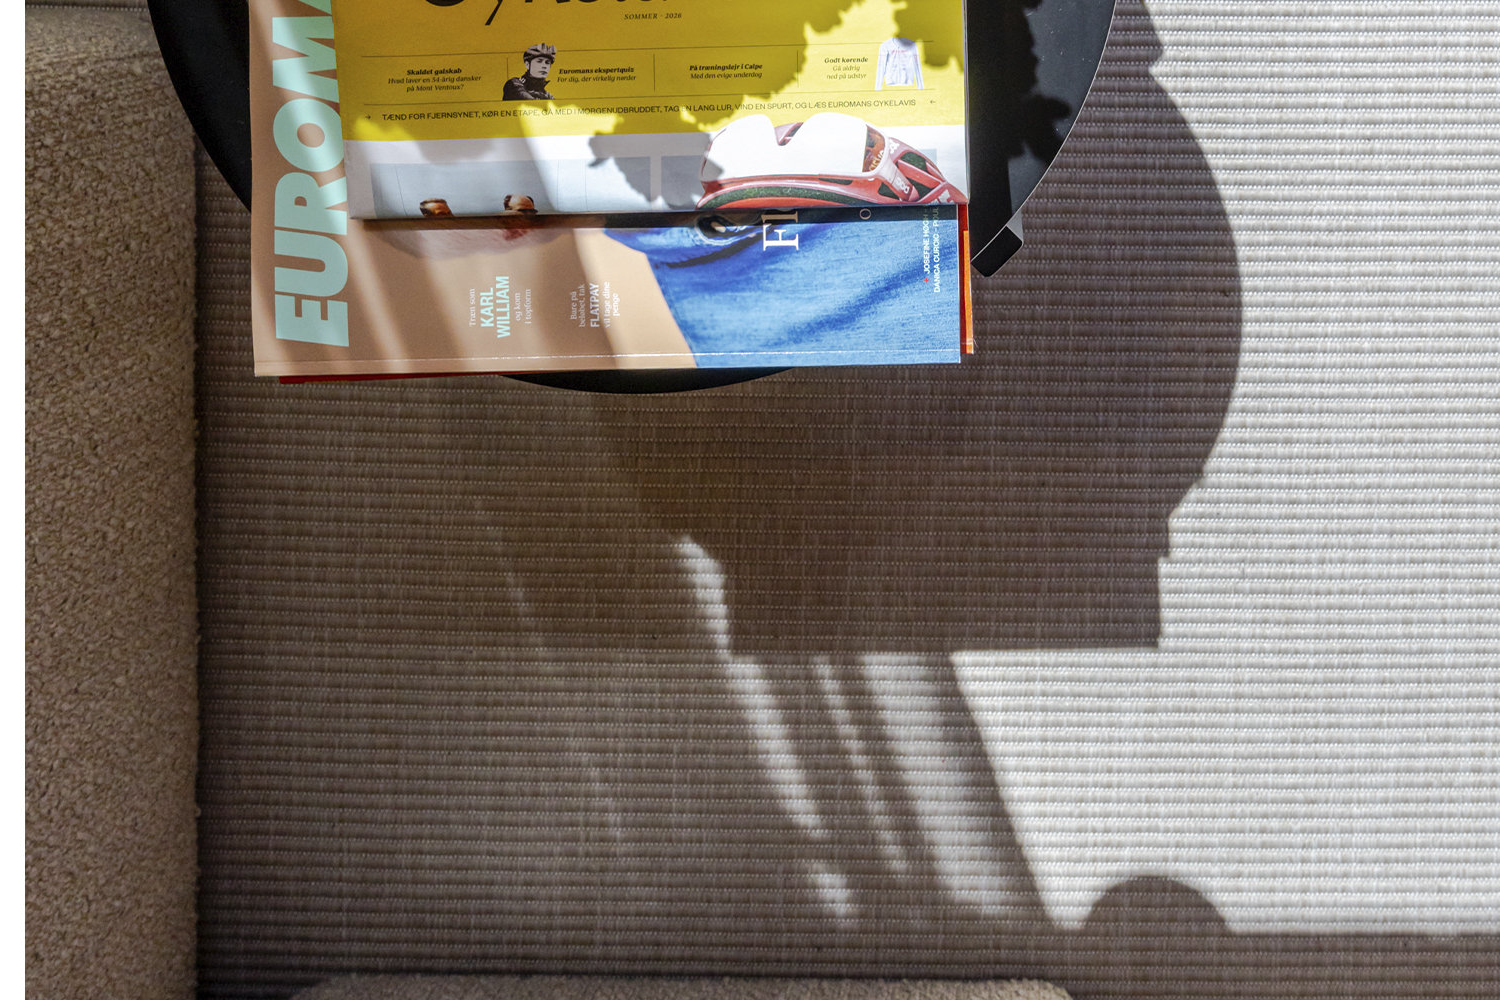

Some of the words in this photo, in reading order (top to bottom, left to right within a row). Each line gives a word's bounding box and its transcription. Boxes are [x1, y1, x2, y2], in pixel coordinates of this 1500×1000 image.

[623, 13, 658, 21] SOMMER
[744, 62, 763, 71] Calpe
[824, 56, 841, 64] Godt
[406, 68, 433, 76] Skaldet
[434, 67, 462, 76] galskab
[558, 67, 594, 75] Euromans
[594, 66, 635, 75] ekspertquiz
[733, 71, 763, 79] underdog
[455, 75, 482, 83] dansker
[406, 85, 415, 93] på
[415, 84, 433, 92] Mont
[381, 112, 407, 121] TÆND
[408, 112, 425, 120] FOR
[426, 111, 481, 121] FJERNSYNET,
[554, 108, 572, 116] MED
[577, 105, 663, 116] MORGENUDBRUDDET,
[664, 105, 680, 113] TAG
[693, 104, 716, 112] LANG
[735, 103, 754, 111] VIND
[809, 101, 827, 109] LÆS
[828, 100, 872, 108] EUROMANS
[873, 99, 916, 107] CYKELAVIS
[923, 238, 931, 274] JOSEFINE
[933, 264, 941, 293] DANICA
[480, 287, 494, 327] KARL
[495, 275, 511, 338] WILLIAM
[513, 292, 521, 310] kom
[524, 289, 533, 320] topform
[589, 282, 600, 328] FLATPAY
